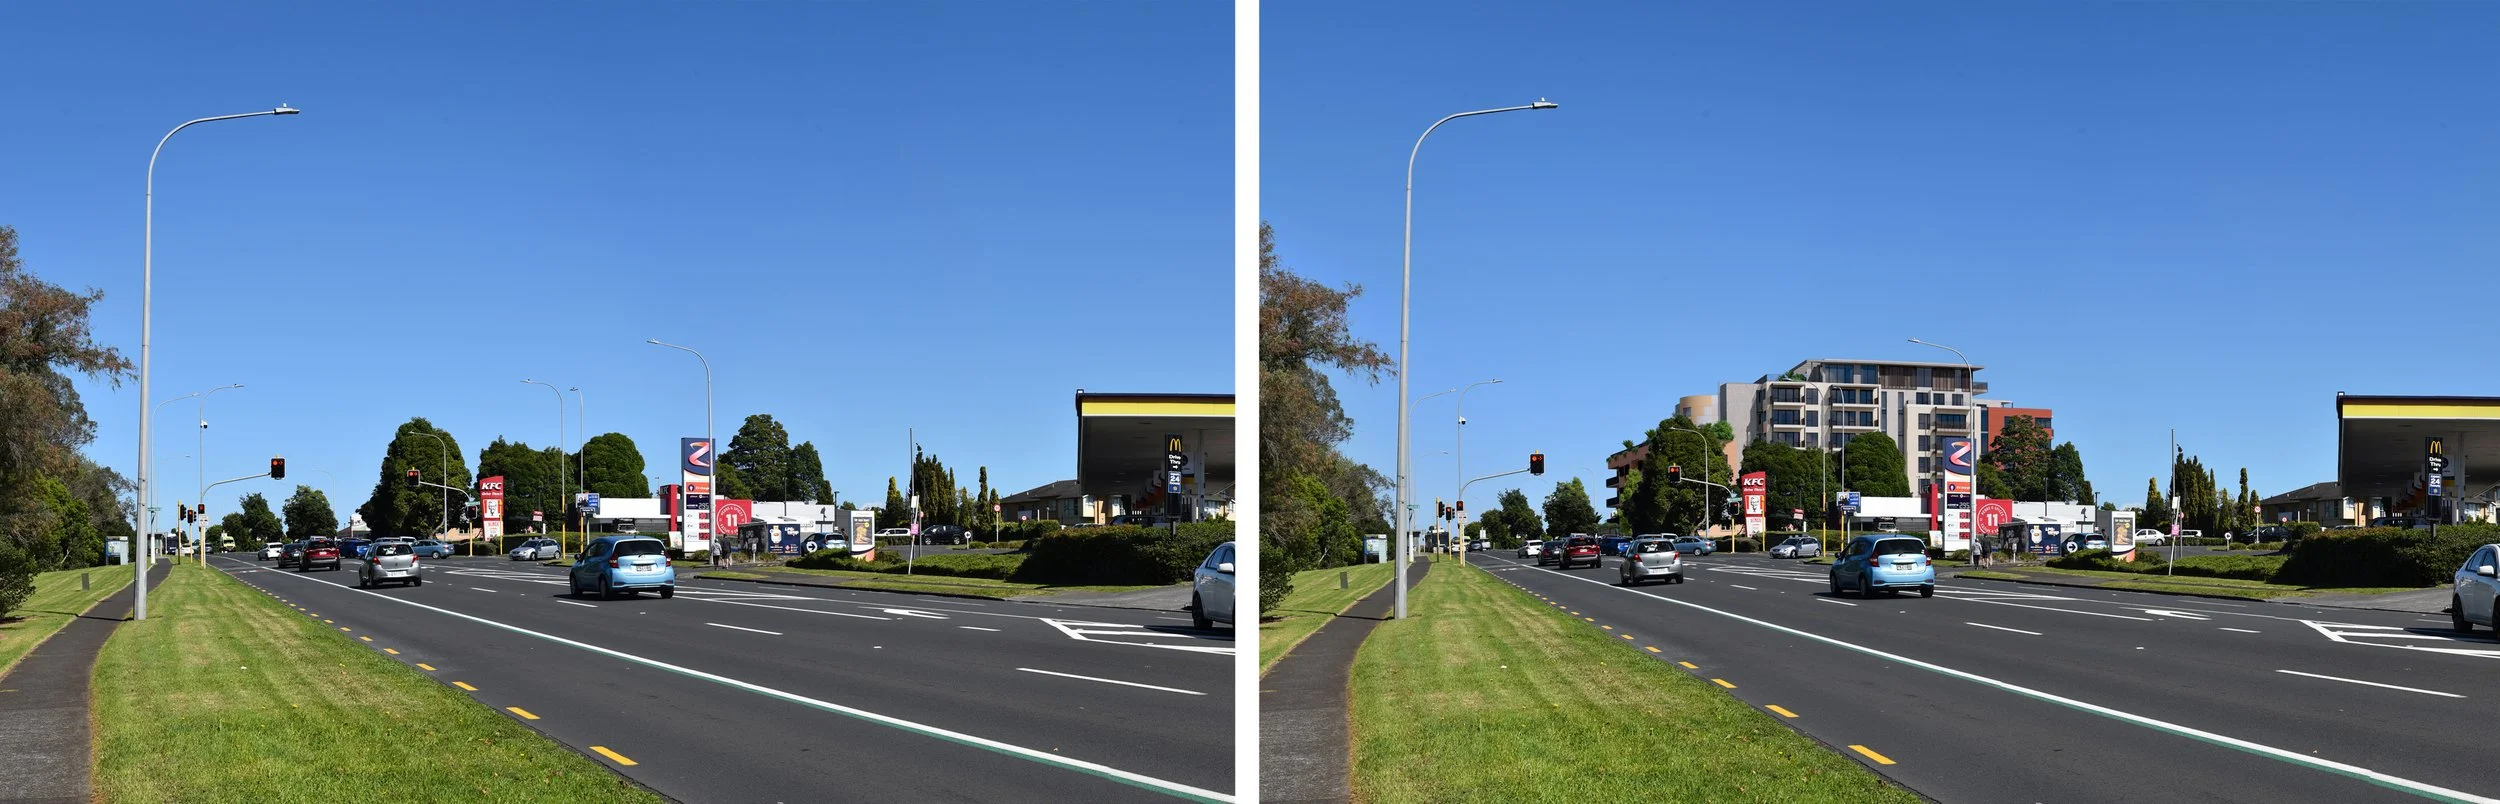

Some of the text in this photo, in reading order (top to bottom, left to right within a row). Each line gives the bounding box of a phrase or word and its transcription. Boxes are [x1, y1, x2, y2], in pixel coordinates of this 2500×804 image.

[482, 482, 502, 490] KFC
[1744, 478, 1765, 486] KFC
[725, 513, 738, 527] 11
[1986, 513, 1999, 527] 11
